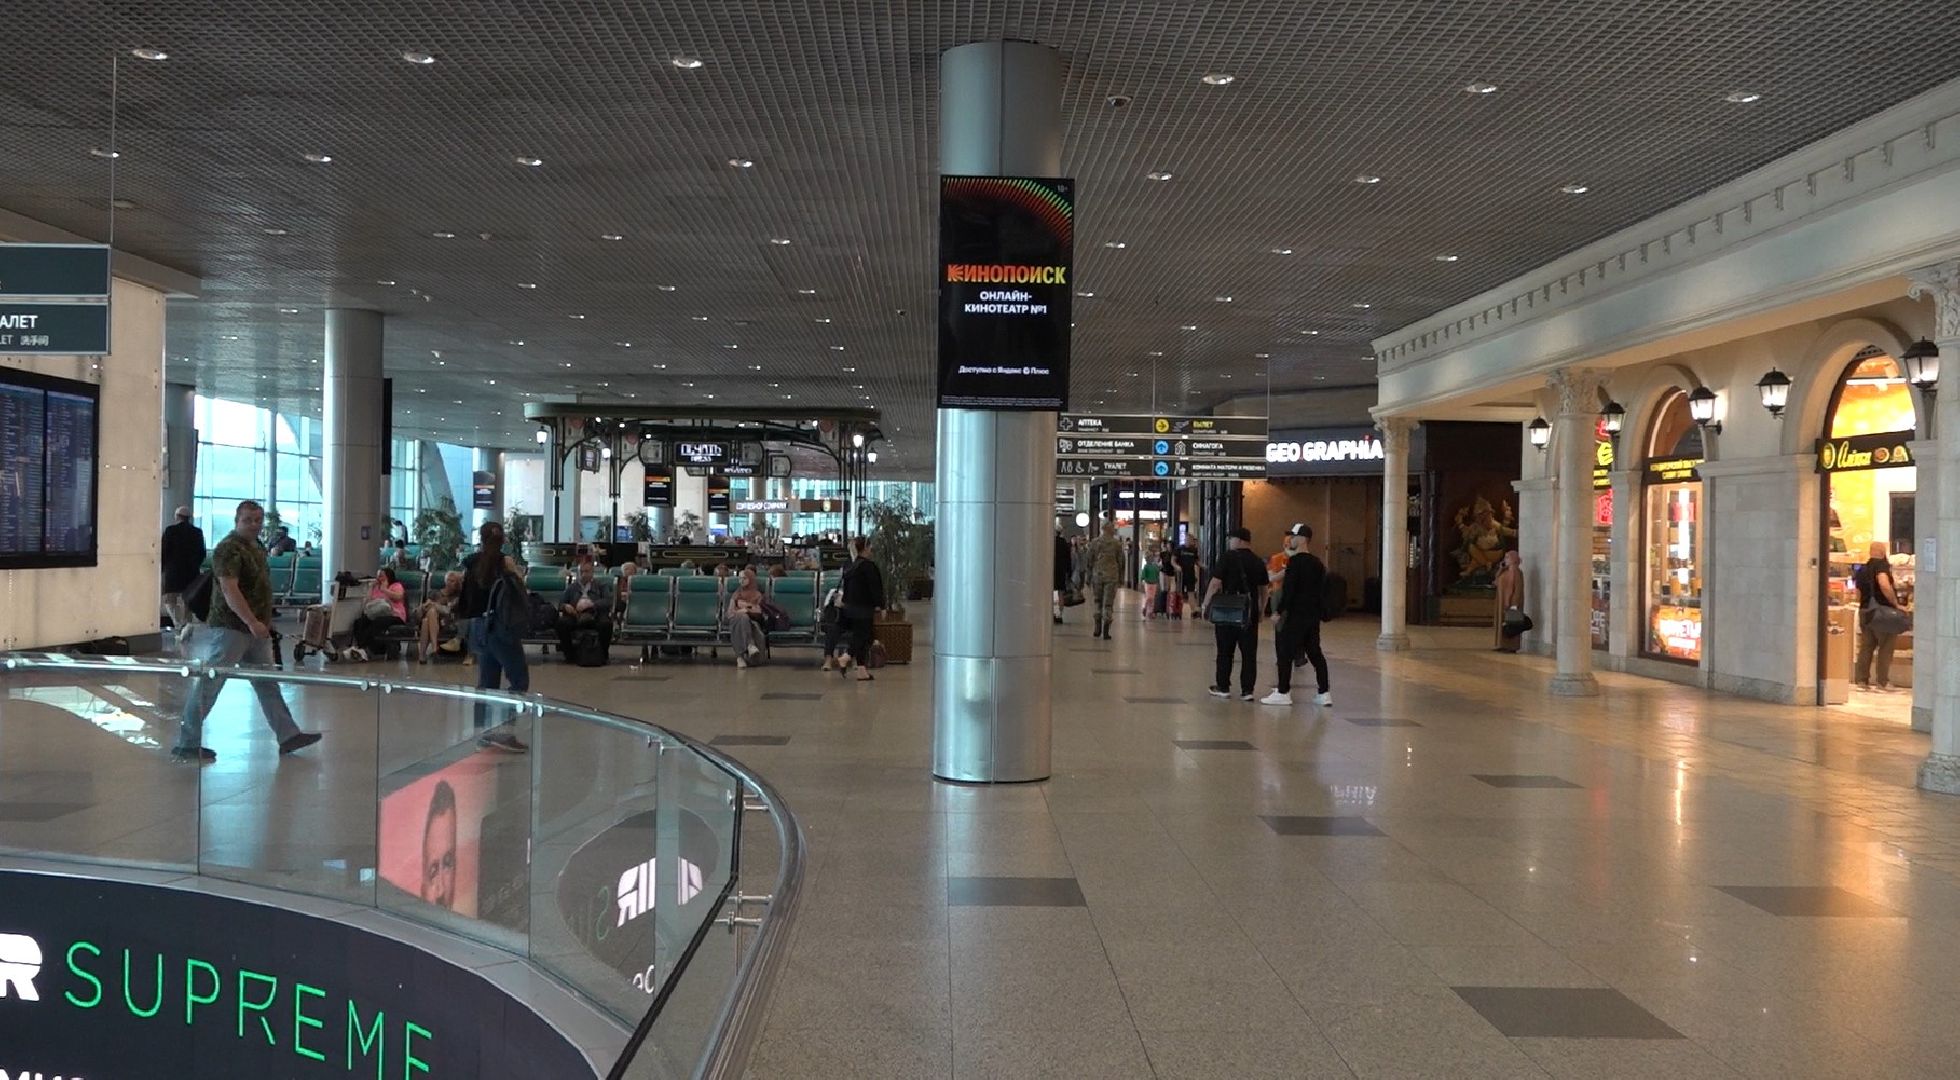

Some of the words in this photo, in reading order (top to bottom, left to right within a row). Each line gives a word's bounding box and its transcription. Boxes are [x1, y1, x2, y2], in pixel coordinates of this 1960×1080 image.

[947, 264, 1066, 284] КИНОПОИСК
[979, 290, 1032, 302] ОНЛАЙН-
[964, 303, 1029, 314] КИНОТЕАТР
[1030, 304, 1047, 315] №1
[1031, 367, 1050, 375] Плюс
[1266, 442, 1300, 462] GEO
[65, 941, 433, 1080] SUPREME
